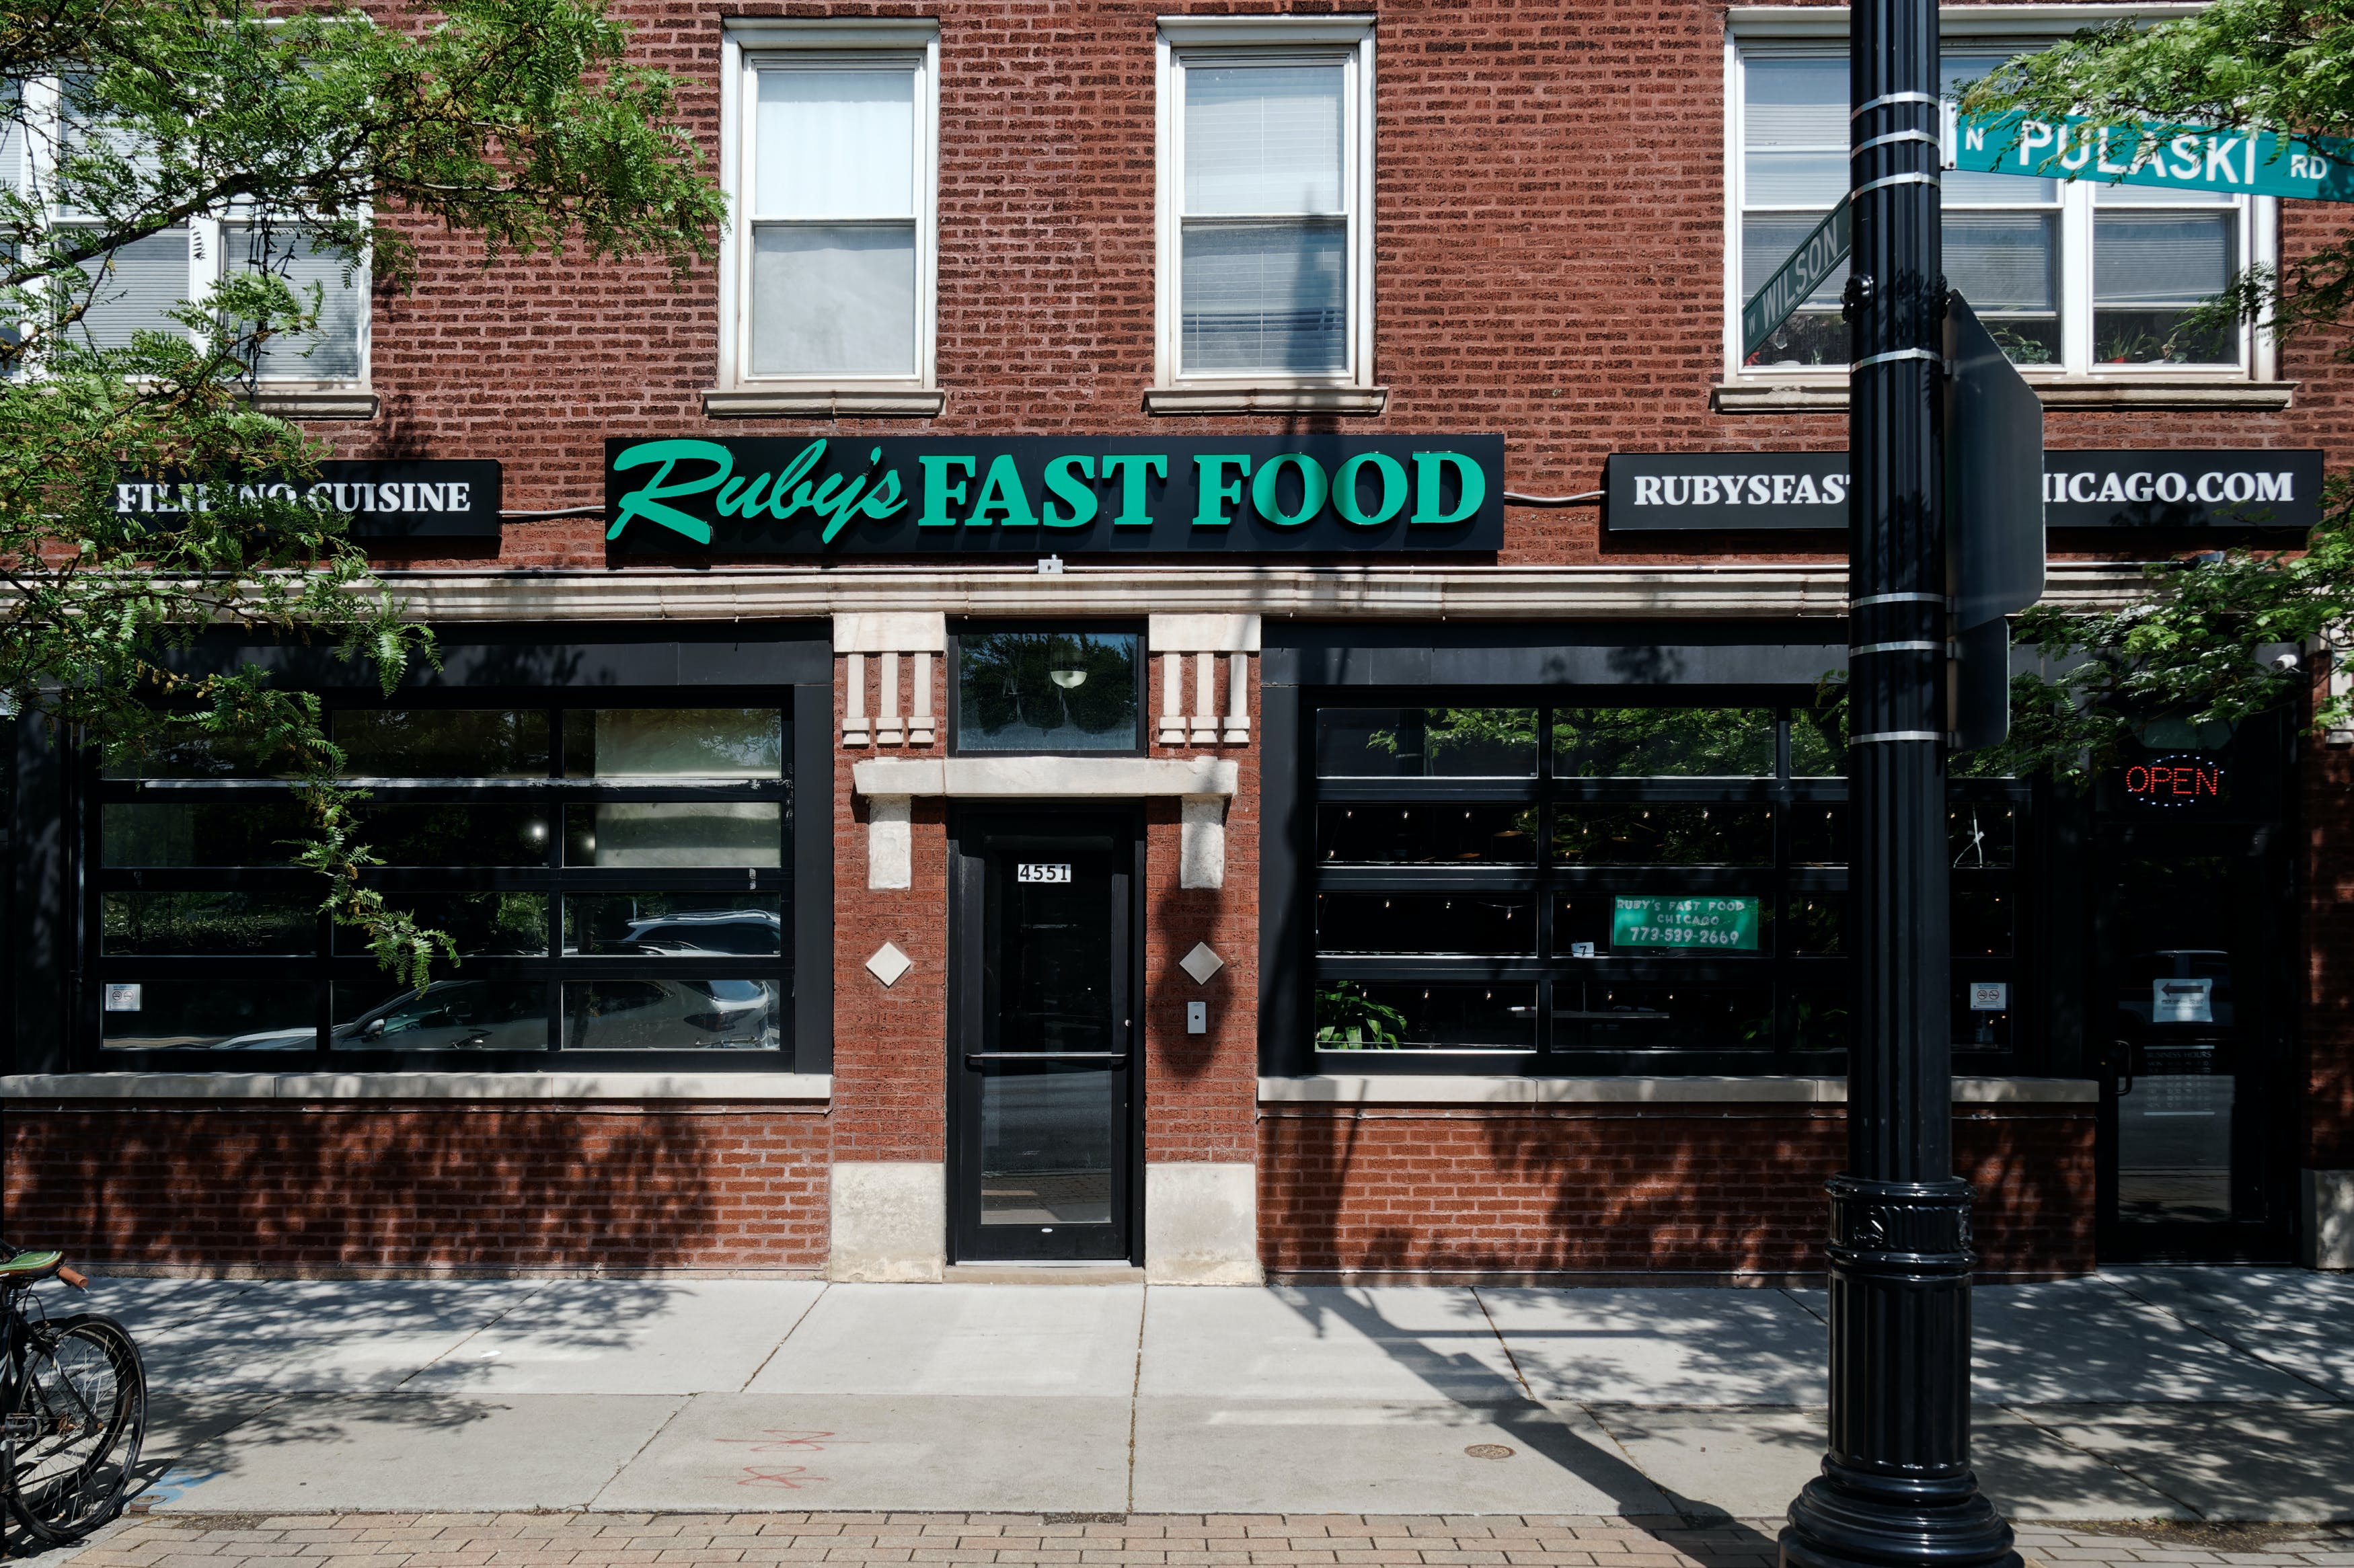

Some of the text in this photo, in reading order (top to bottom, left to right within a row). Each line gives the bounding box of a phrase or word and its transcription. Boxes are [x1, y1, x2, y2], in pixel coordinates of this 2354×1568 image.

[1965, 119, 2327, 185] N PULASKI RD
[1748, 215, 1837, 337] W WILSON
[116, 482, 471, 513] FILIPNO CUISINE
[606, 439, 1486, 545] Ruby's FAST FOOD
[2125, 766, 2218, 795] OPEN
[1019, 865, 1068, 881] 4551
[1616, 899, 1745, 912] RUBY'S FAST FOOD
[1657, 914, 1720, 925] CHICAGO
[1630, 925, 1740, 945] 773-539-2669
